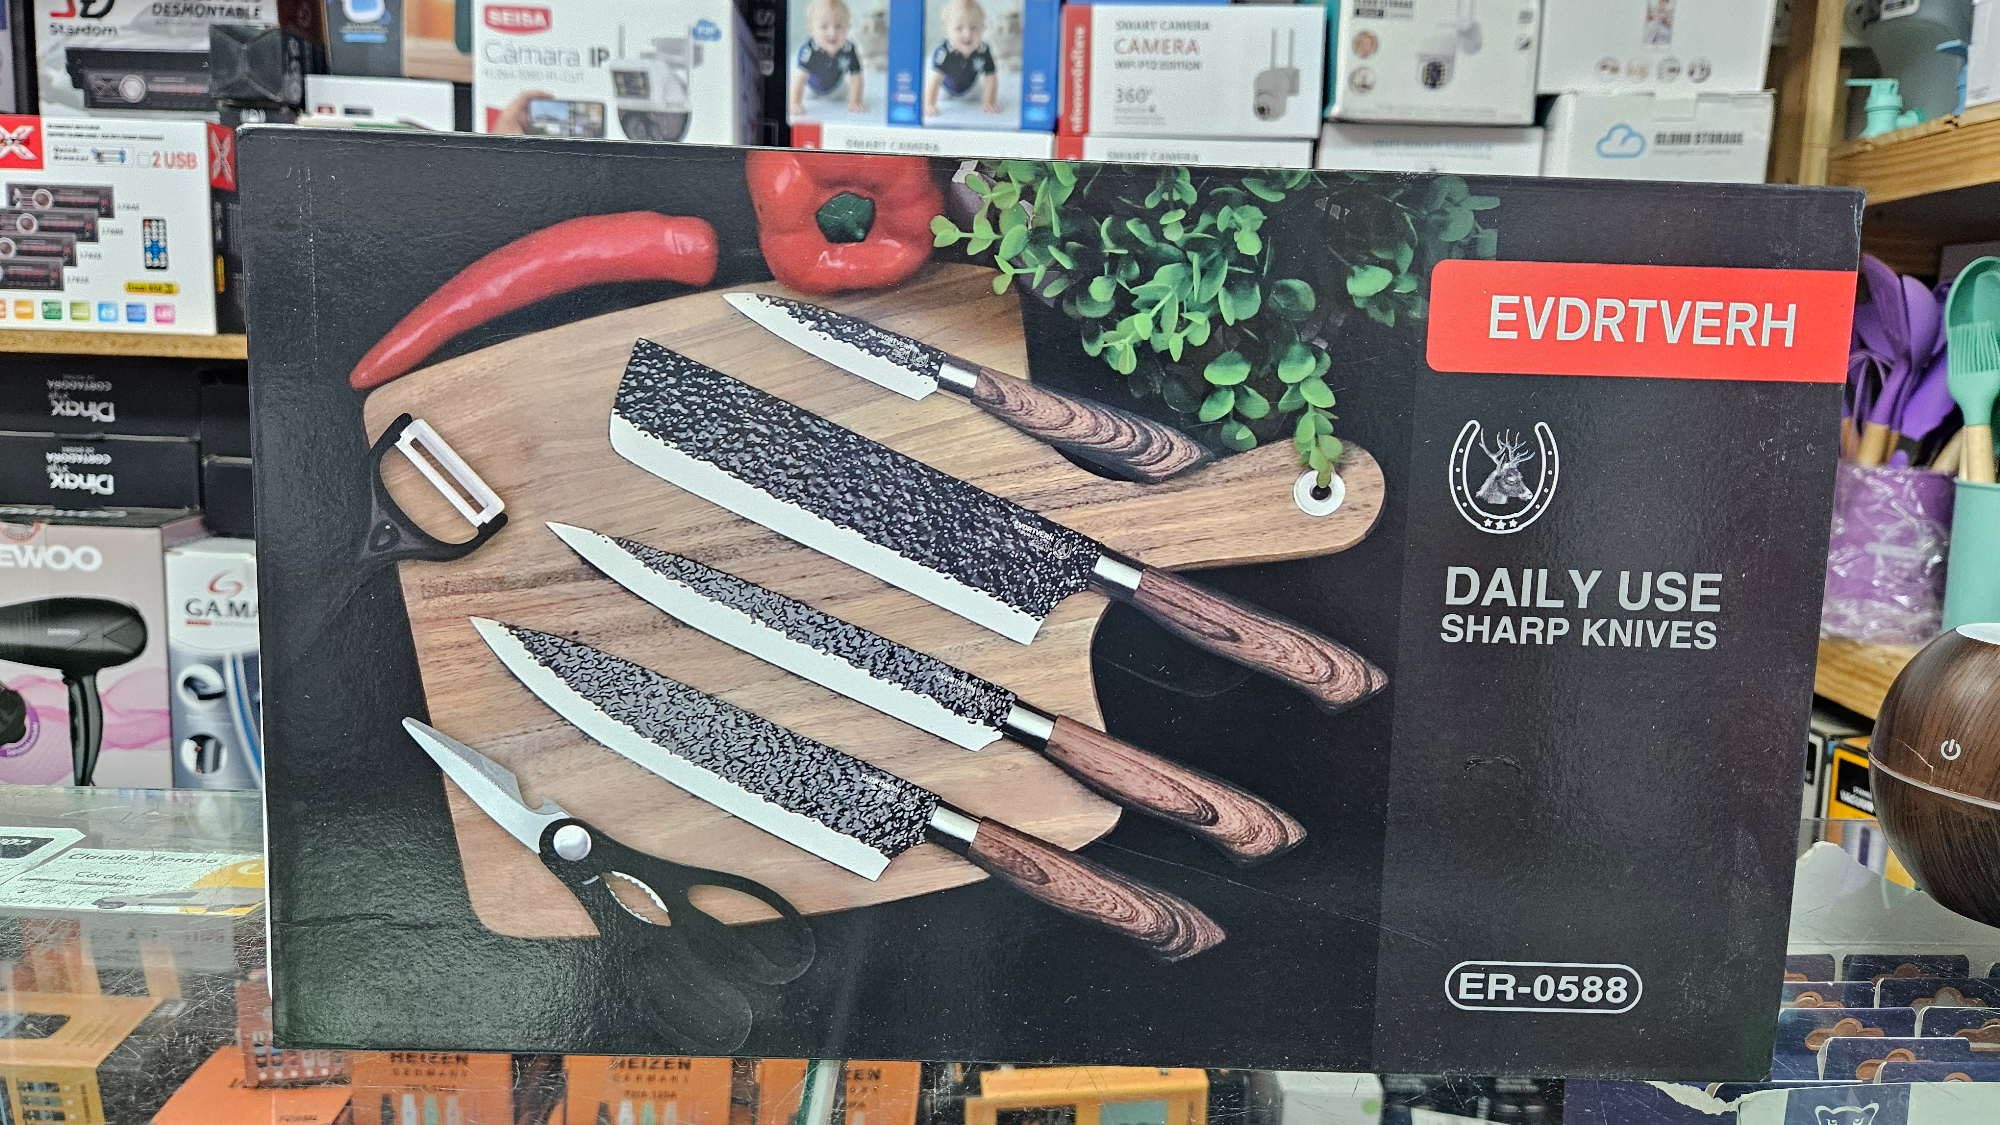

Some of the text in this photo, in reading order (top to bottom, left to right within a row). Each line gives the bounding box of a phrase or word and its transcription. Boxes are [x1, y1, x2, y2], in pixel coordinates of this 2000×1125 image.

[152, 4, 262, 20] DESMONTABLE
[486, 8, 548, 28] SEISA
[50, 22, 118, 37] Stardom
[1115, 20, 1211, 32] SMART CAMERA
[1114, 38, 1199, 55] CAMERA
[589, 47, 610, 68] IP
[153, 151, 198, 169] 2 USB
[1489, 295, 1797, 348] EVDRTVERH
[51, 401, 115, 423] Dinax
[50, 473, 115, 495] Dinax
[1445, 566, 1723, 613] DAILY USE
[1440, 613, 1718, 650] SHARP KNIVES
[1458, 972, 1628, 1004] ER-0588
[613, 1057, 691, 1070] HEIZEN
